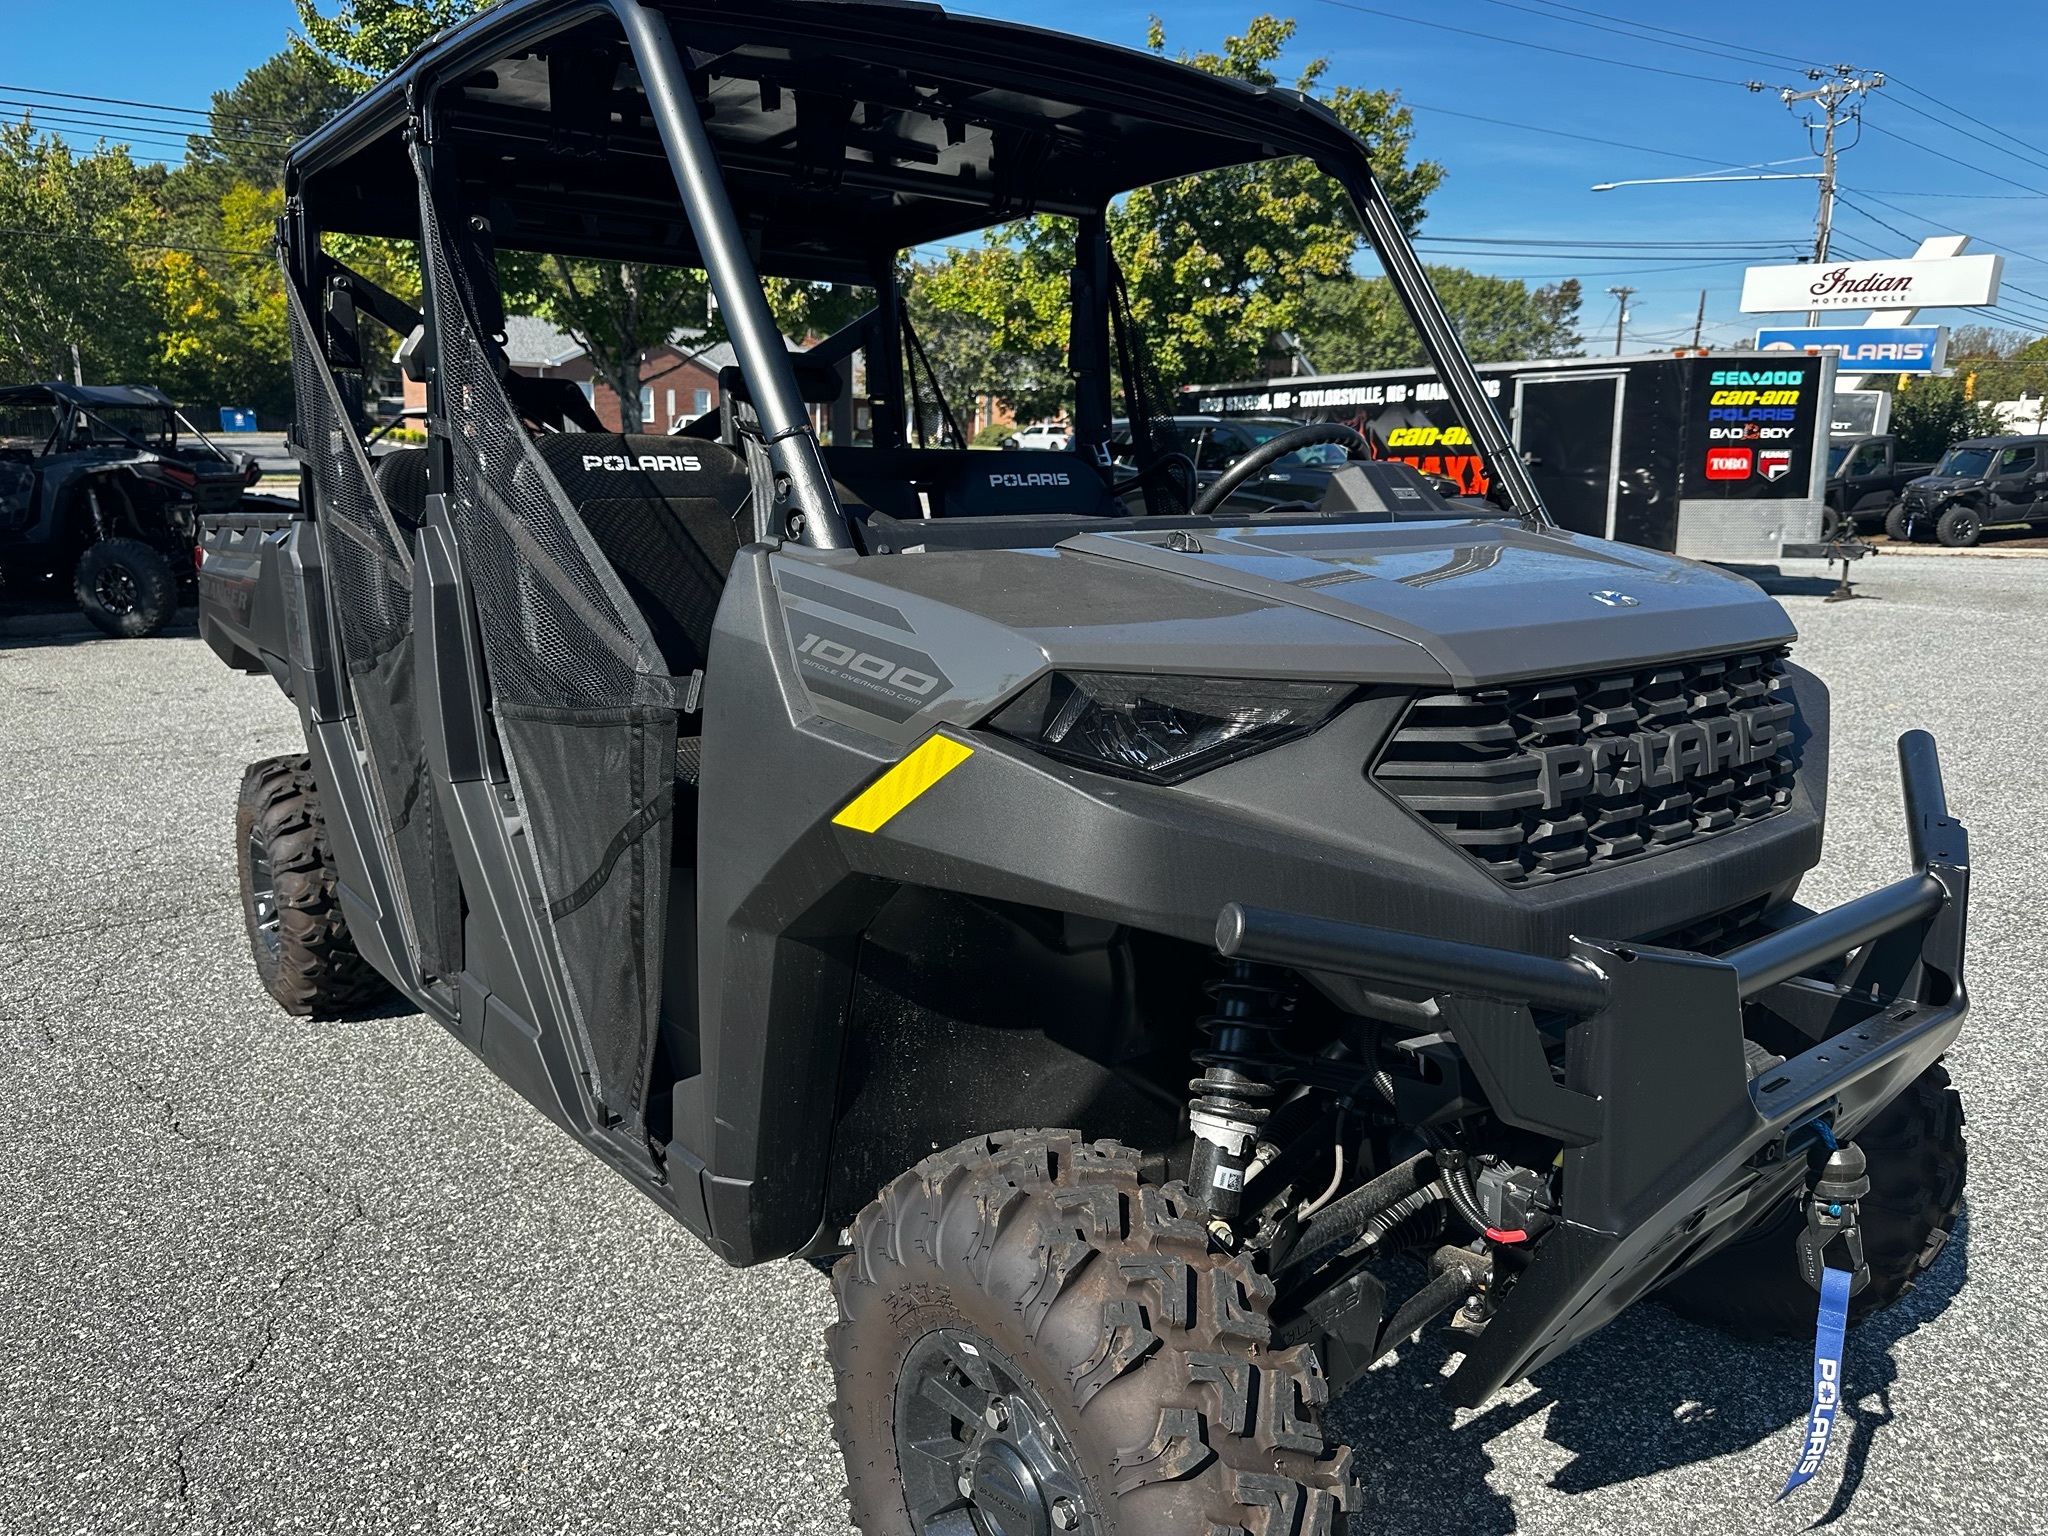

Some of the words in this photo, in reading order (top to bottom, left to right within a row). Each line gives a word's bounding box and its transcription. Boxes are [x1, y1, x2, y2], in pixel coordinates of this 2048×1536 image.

[1810, 267, 1913, 295] Indian
[1812, 295, 1906, 304] MOTORCYCLE
[1299, 386, 1384, 408] TAYLORSVILLE,
[1386, 384, 1406, 403] NC
[1709, 408, 1796, 421] POLARIS
[1709, 428, 1743, 439] BAD
[1760, 428, 1794, 439] BOY
[582, 455, 702, 471] POLARIS
[1710, 458, 1749, 471] TORO
[989, 473, 1070, 487] POLARIS
[797, 633, 939, 695] 1000
[802, 658, 838, 675] SINGLE
[840, 672, 896, 696] OVERHEAD
[897, 693, 922, 706] CAM
[1540, 706, 1779, 810] POLARIS
[1799, 1359, 1837, 1474] POLARIS
